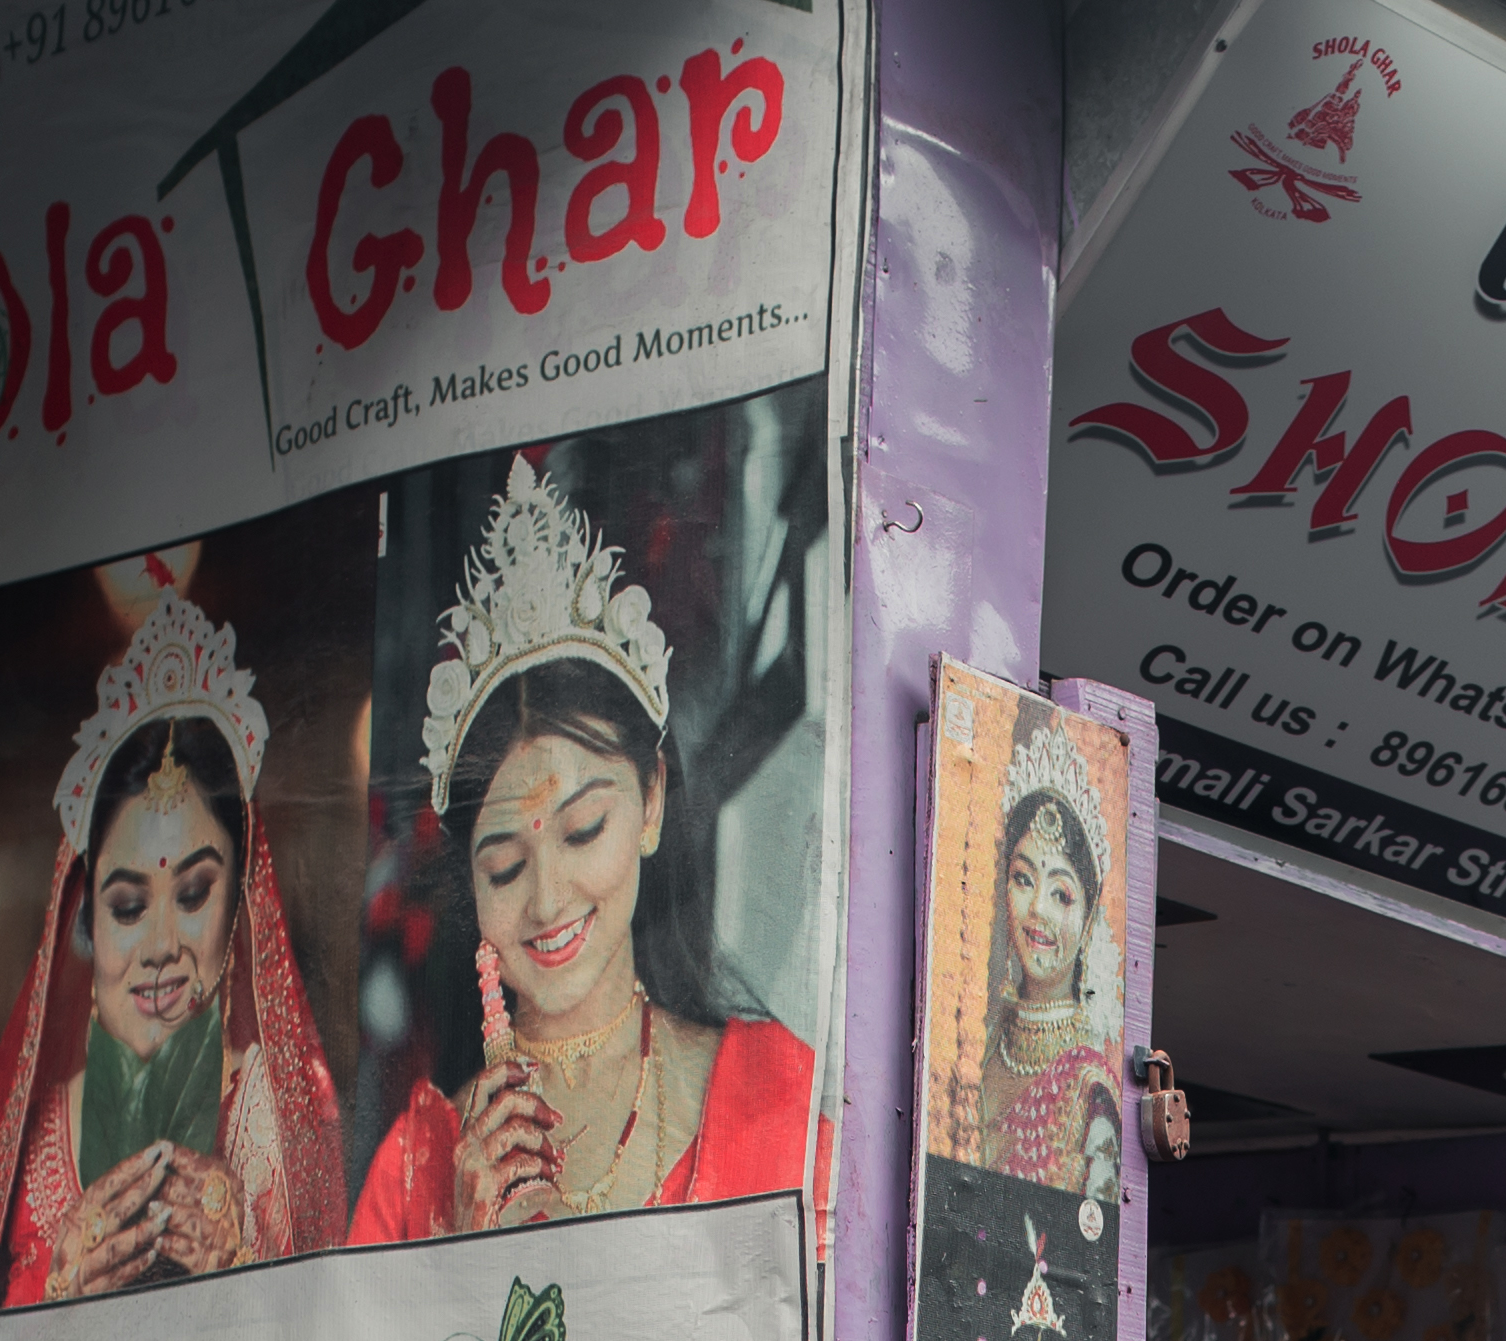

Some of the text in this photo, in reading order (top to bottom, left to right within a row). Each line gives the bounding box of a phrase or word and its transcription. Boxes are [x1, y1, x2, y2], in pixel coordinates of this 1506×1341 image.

[3, 4, 67, 64] +91
[1311, 35, 1403, 99] SHOLA GHAR
[306, 40, 785, 350] Ghar
[1250, 197, 1288, 221] KOLKATA
[274, 302, 810, 456] Good Craft, Makes Good Moments...
[1121, 542, 1287, 635] Order
[1290, 618, 1362, 669] on
[1138, 643, 1250, 711] Call
[1249, 692, 1318, 738] us
[1158, 746, 1271, 813] mali
[1270, 785, 1443, 873] Sarkar
